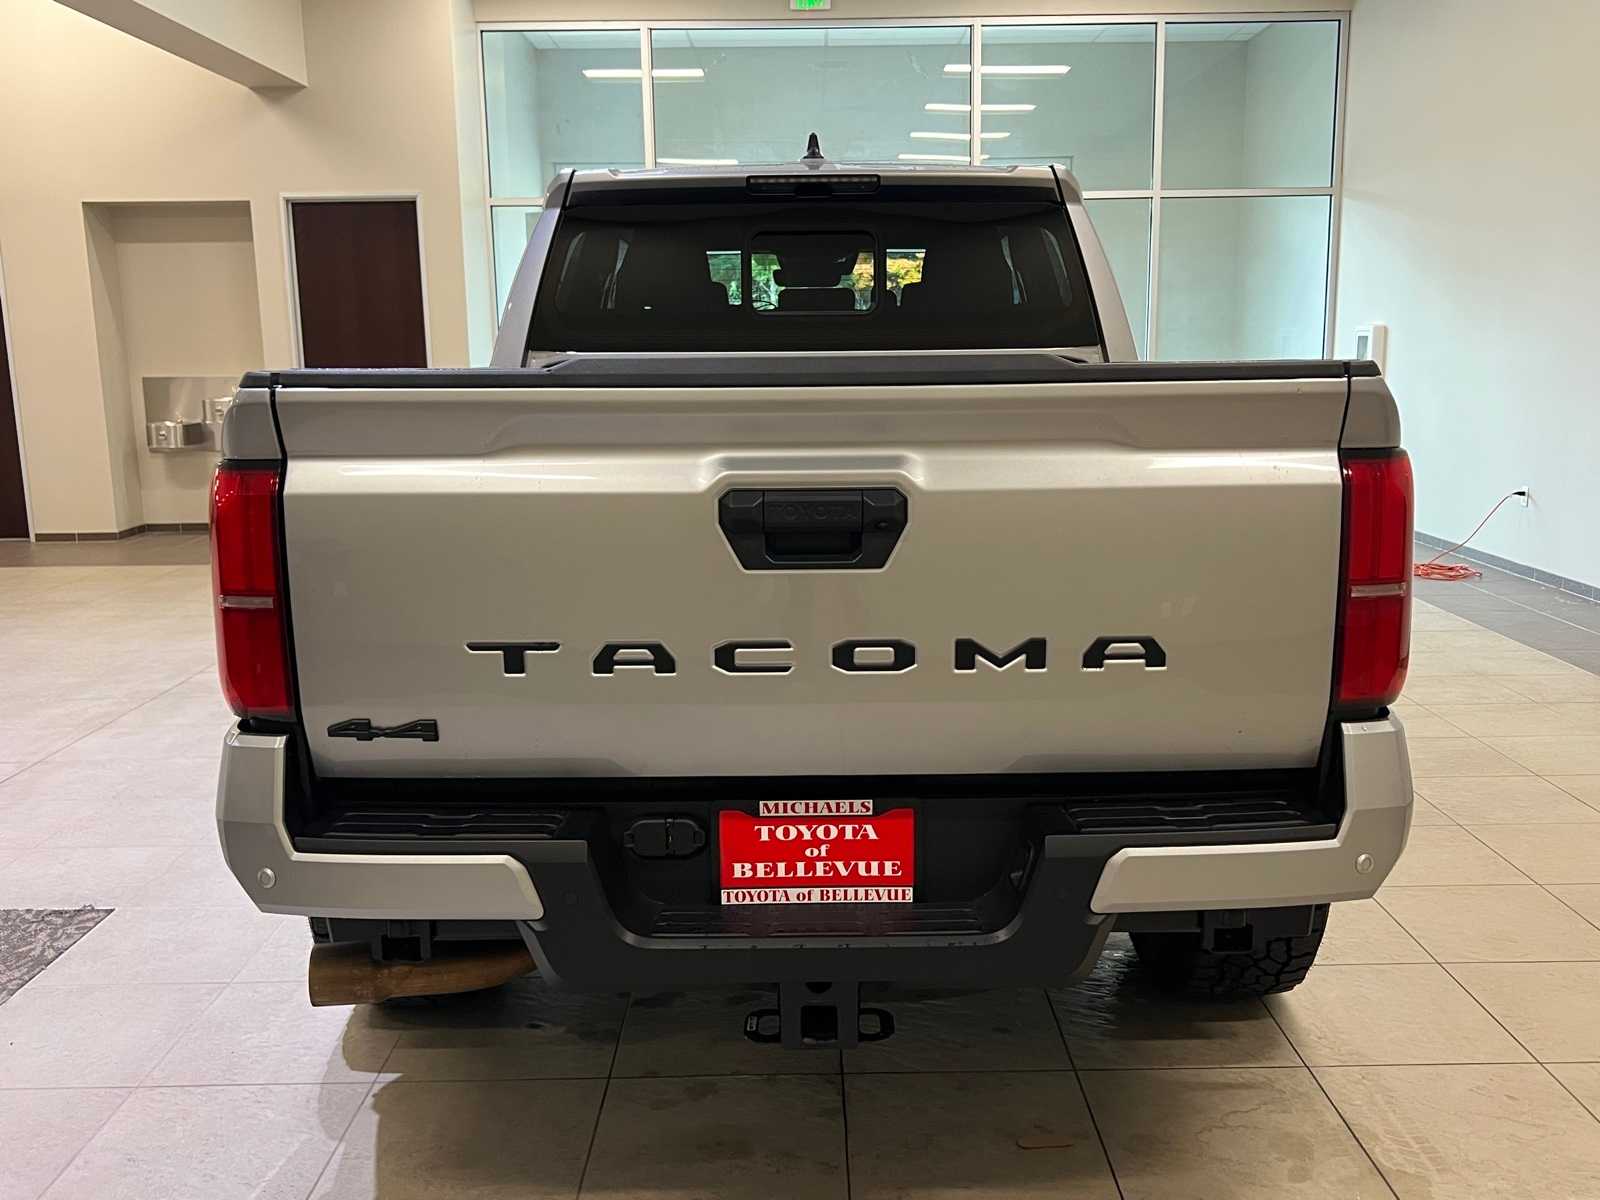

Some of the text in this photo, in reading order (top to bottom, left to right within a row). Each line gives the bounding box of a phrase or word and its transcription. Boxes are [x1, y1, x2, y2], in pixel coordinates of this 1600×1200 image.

[464, 636, 1168, 676] TACOMA
[762, 801, 871, 814] MICHAELS
[754, 824, 878, 841] TOYOTA
[804, 844, 830, 857] of
[732, 860, 902, 878] BELLEVUE
[722, 889, 912, 903] TOYOTA of BELLEVUE
